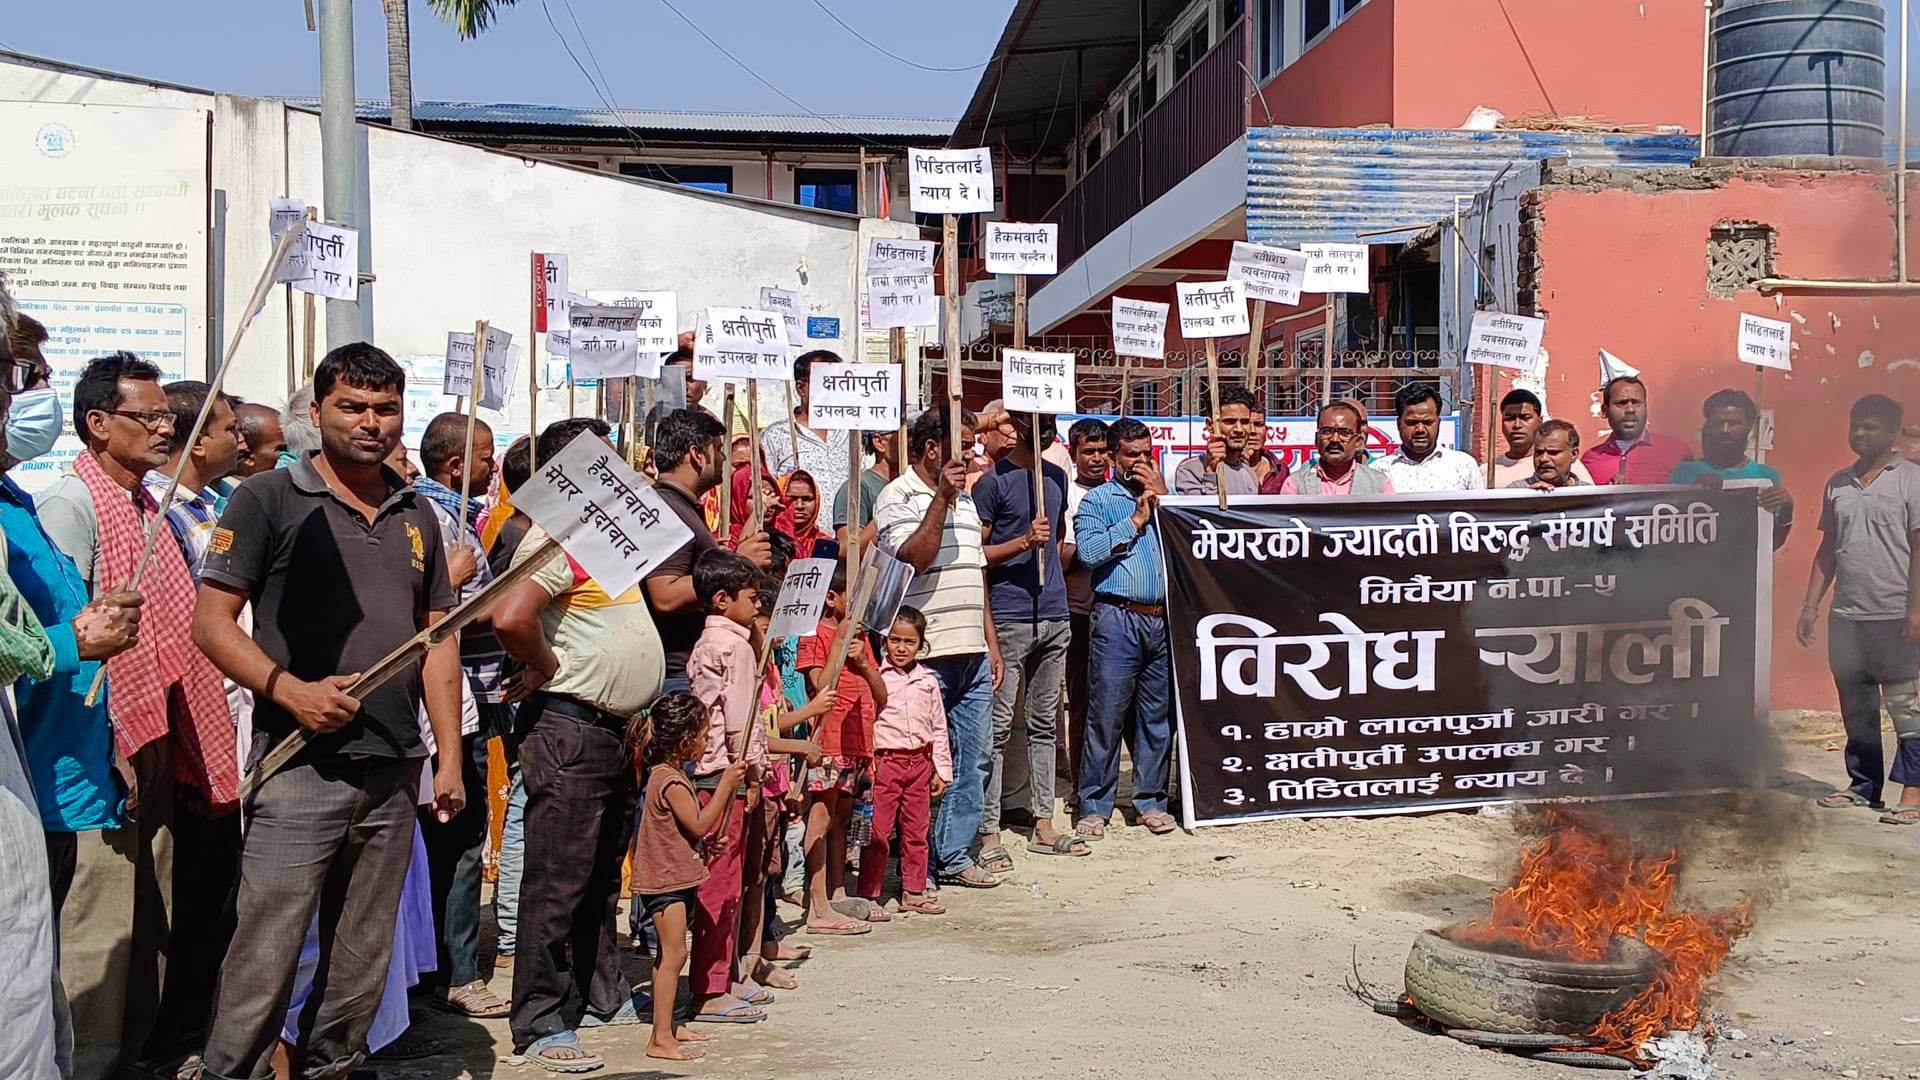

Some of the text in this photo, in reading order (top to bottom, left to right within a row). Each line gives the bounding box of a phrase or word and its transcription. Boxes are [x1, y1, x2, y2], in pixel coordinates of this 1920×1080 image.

[915, 155, 983, 174] पिडितलाई
[920, 186, 951, 199] न्याय
[960, 184, 969, 199] दे
[994, 227, 1048, 244] हैकमवादी
[876, 243, 927, 261] पिडितलाई
[1312, 264, 1331, 274] जारी
[1337, 266, 1348, 275] गर
[323, 270, 342, 287] गर
[880, 293, 898, 306] जारी
[902, 295, 914, 305] गर
[571, 314, 594, 328] हाम्रो
[1220, 315, 1236, 325] गर
[722, 316, 777, 344] क्षतीपुर्ती
[581, 336, 600, 352] जारी
[605, 340, 617, 352] गर
[1746, 343, 1766, 356] न्याय
[1769, 345, 1776, 359] दे
[763, 353, 778, 367] गर
[1010, 356, 1066, 377] पिडितलाई
[823, 370, 889, 396] क्षतीपुर्ती
[1012, 385, 1039, 399] न्याय
[1044, 383, 1053, 399] दे
[869, 406, 888, 418] गर
[1191, 517, 1312, 561] मेयरको
[1321, 513, 1440, 559] ज्यादती
[1541, 507, 1616, 552] संघर्ष
[1624, 501, 1720, 548] समिति
[1195, 612, 1445, 701] विरोध
[1264, 716, 1348, 740] हाम्रो
[1359, 708, 1515, 738] लालपुर्जा
[1526, 703, 1607, 727] जारी
[1618, 703, 1675, 721] गर
[1264, 743, 1407, 771] क्षतीपुर्ती
[1554, 736, 1610, 753] गर
[1267, 772, 1443, 802] पिडितलाई
[1454, 769, 1548, 790] न्याय
[1558, 763, 1586, 785] दे
